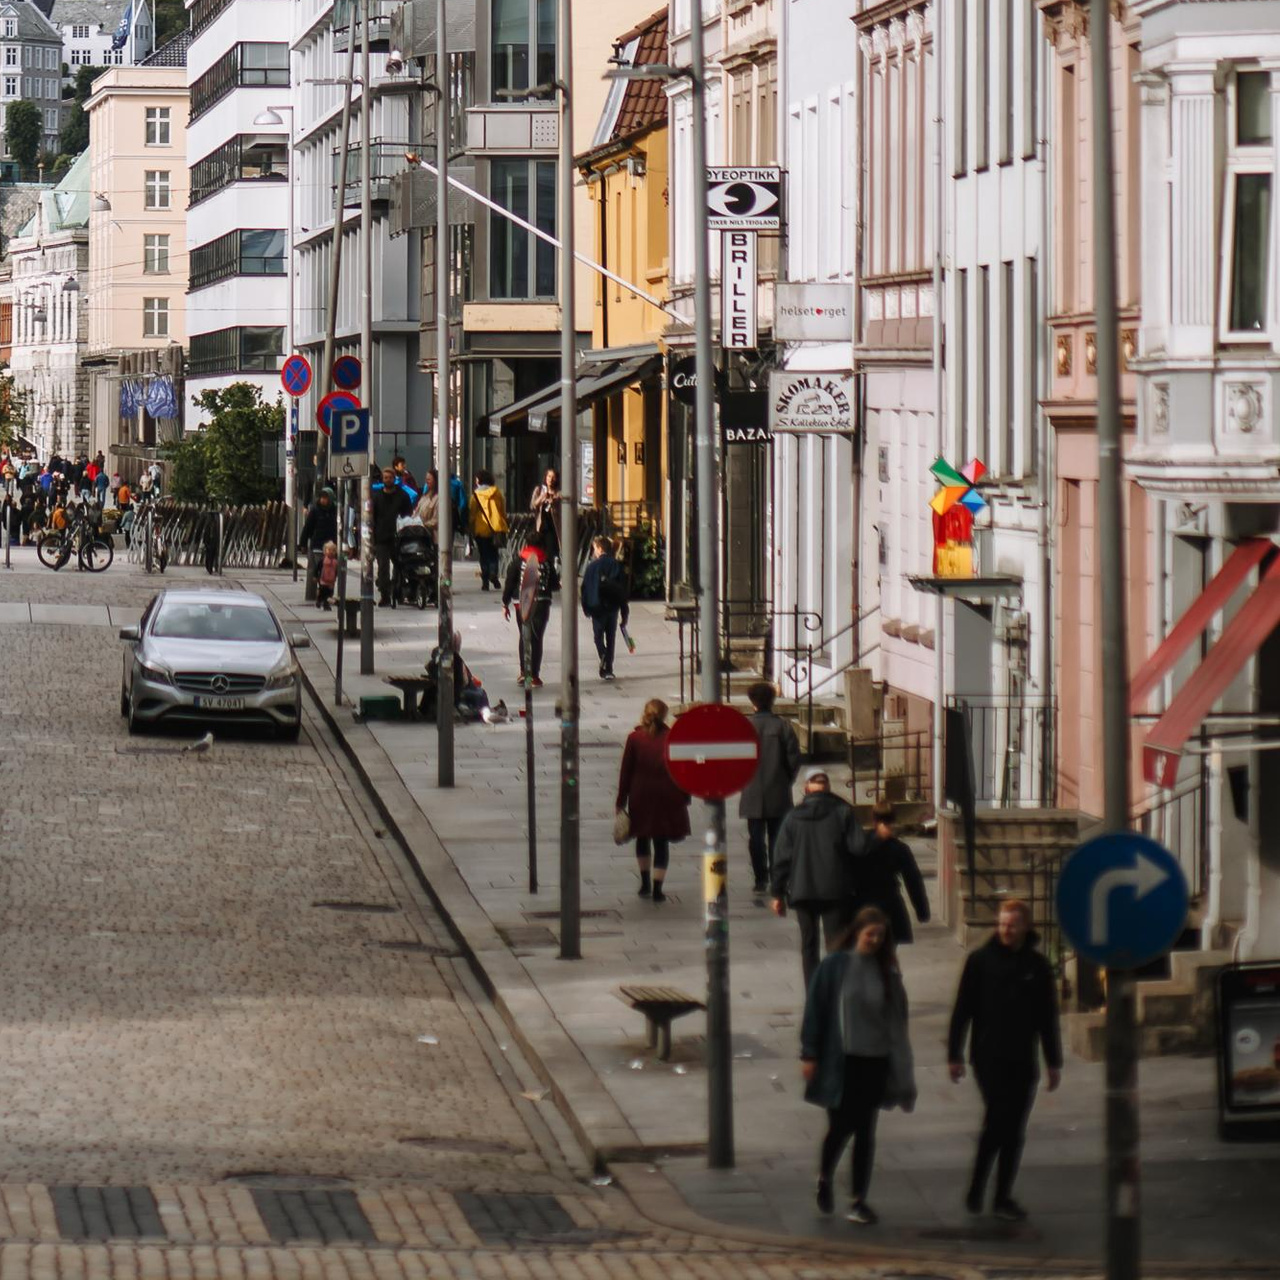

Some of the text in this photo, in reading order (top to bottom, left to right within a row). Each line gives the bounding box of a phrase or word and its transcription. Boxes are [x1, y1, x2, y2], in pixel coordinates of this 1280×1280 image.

[731, 233, 748, 346] BRILLER
[776, 377, 850, 415] SKOMAKER
[341, 414, 361, 448] P
